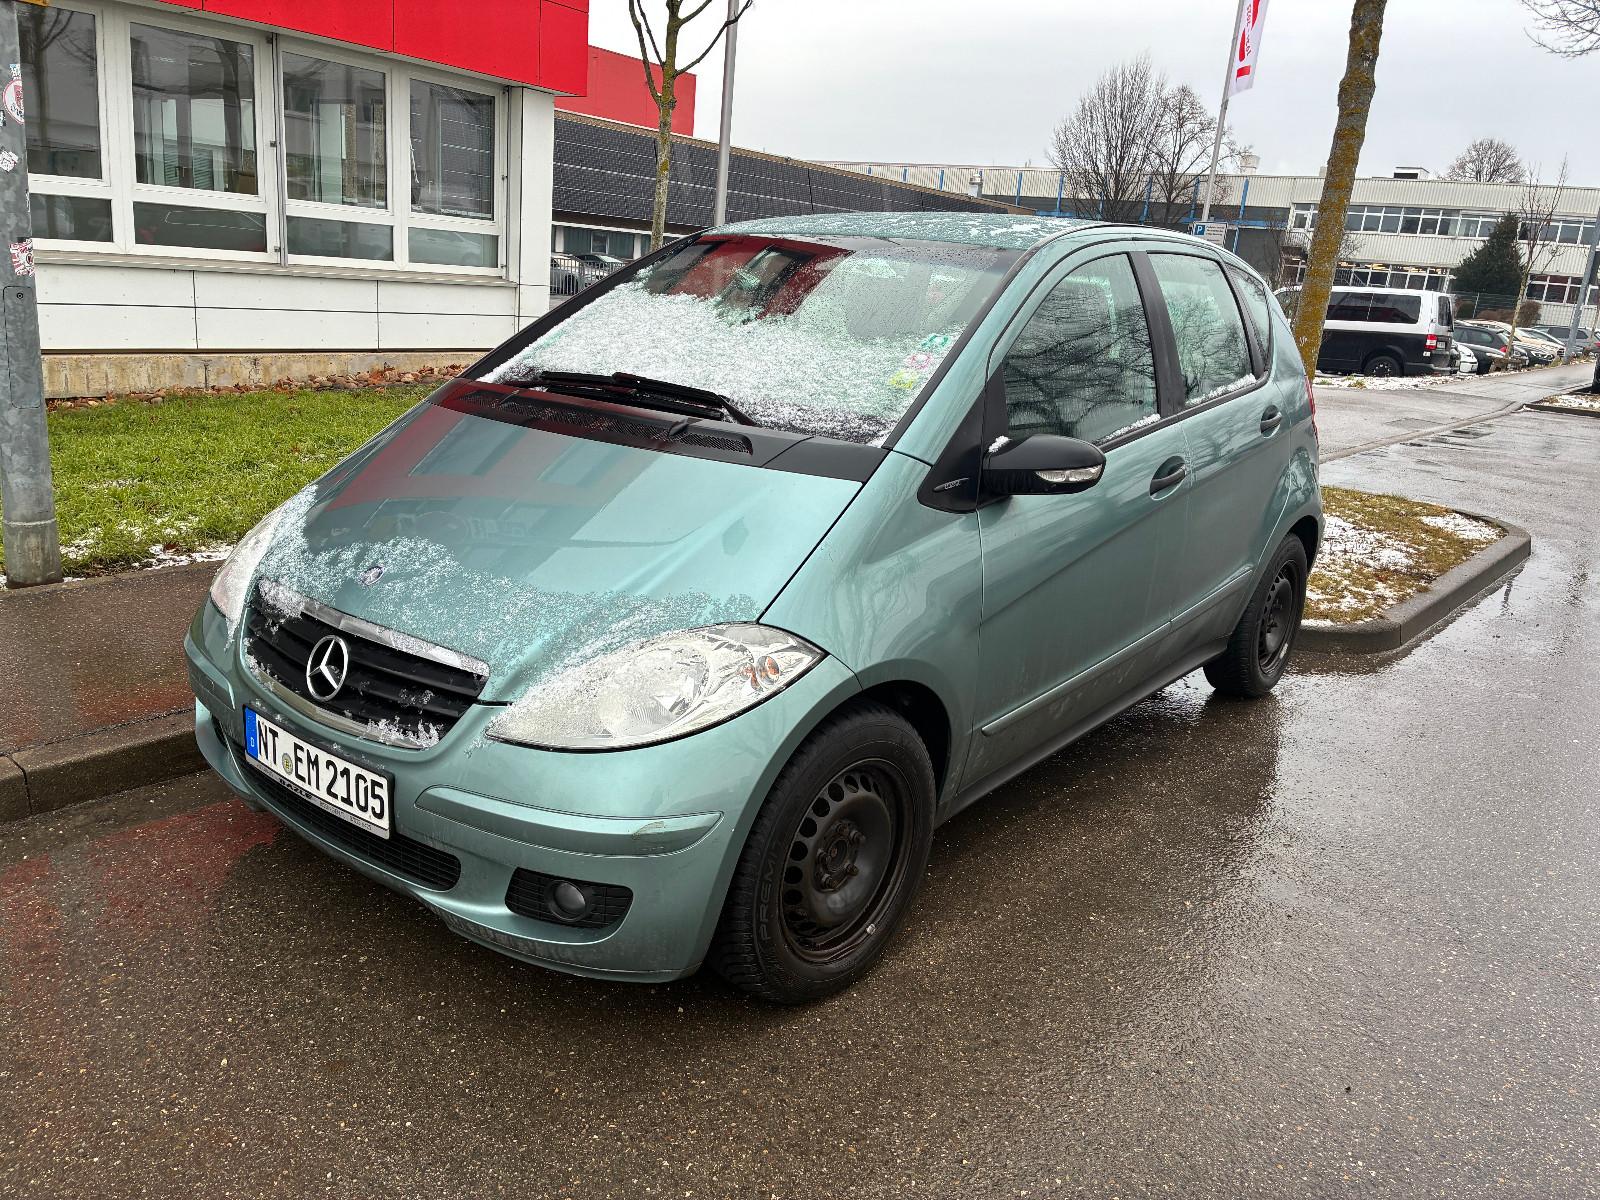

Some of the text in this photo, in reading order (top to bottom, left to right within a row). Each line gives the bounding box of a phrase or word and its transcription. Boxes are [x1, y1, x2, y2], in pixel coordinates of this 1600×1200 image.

[257, 720, 279, 767] NT
[293, 741, 321, 792] EM
[325, 759, 386, 820] 2105
